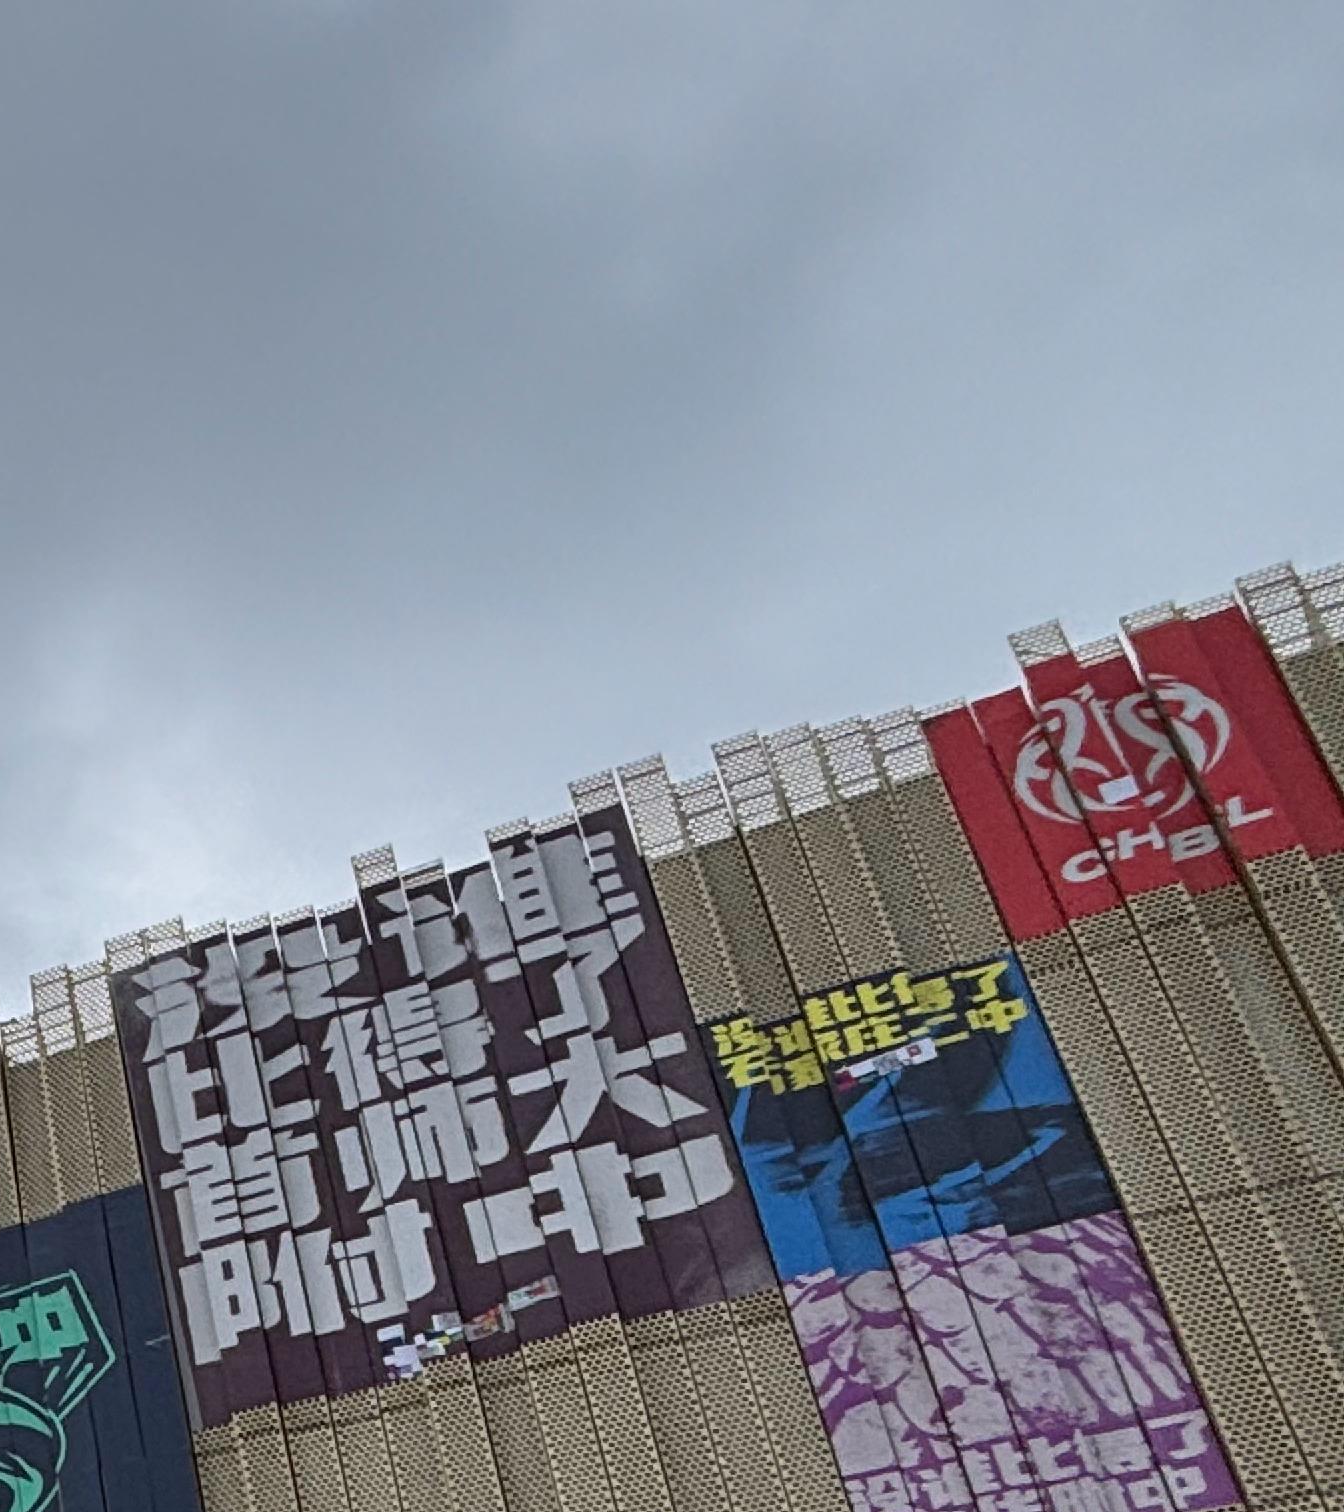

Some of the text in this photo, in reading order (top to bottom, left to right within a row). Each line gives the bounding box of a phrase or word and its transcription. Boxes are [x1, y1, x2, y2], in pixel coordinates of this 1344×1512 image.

[1061, 797, 1274, 883] CHBL
[148, 914, 645, 1154] 比得了
[161, 1032, 709, 1257] 首师大
[179, 1135, 734, 1366] 附中
